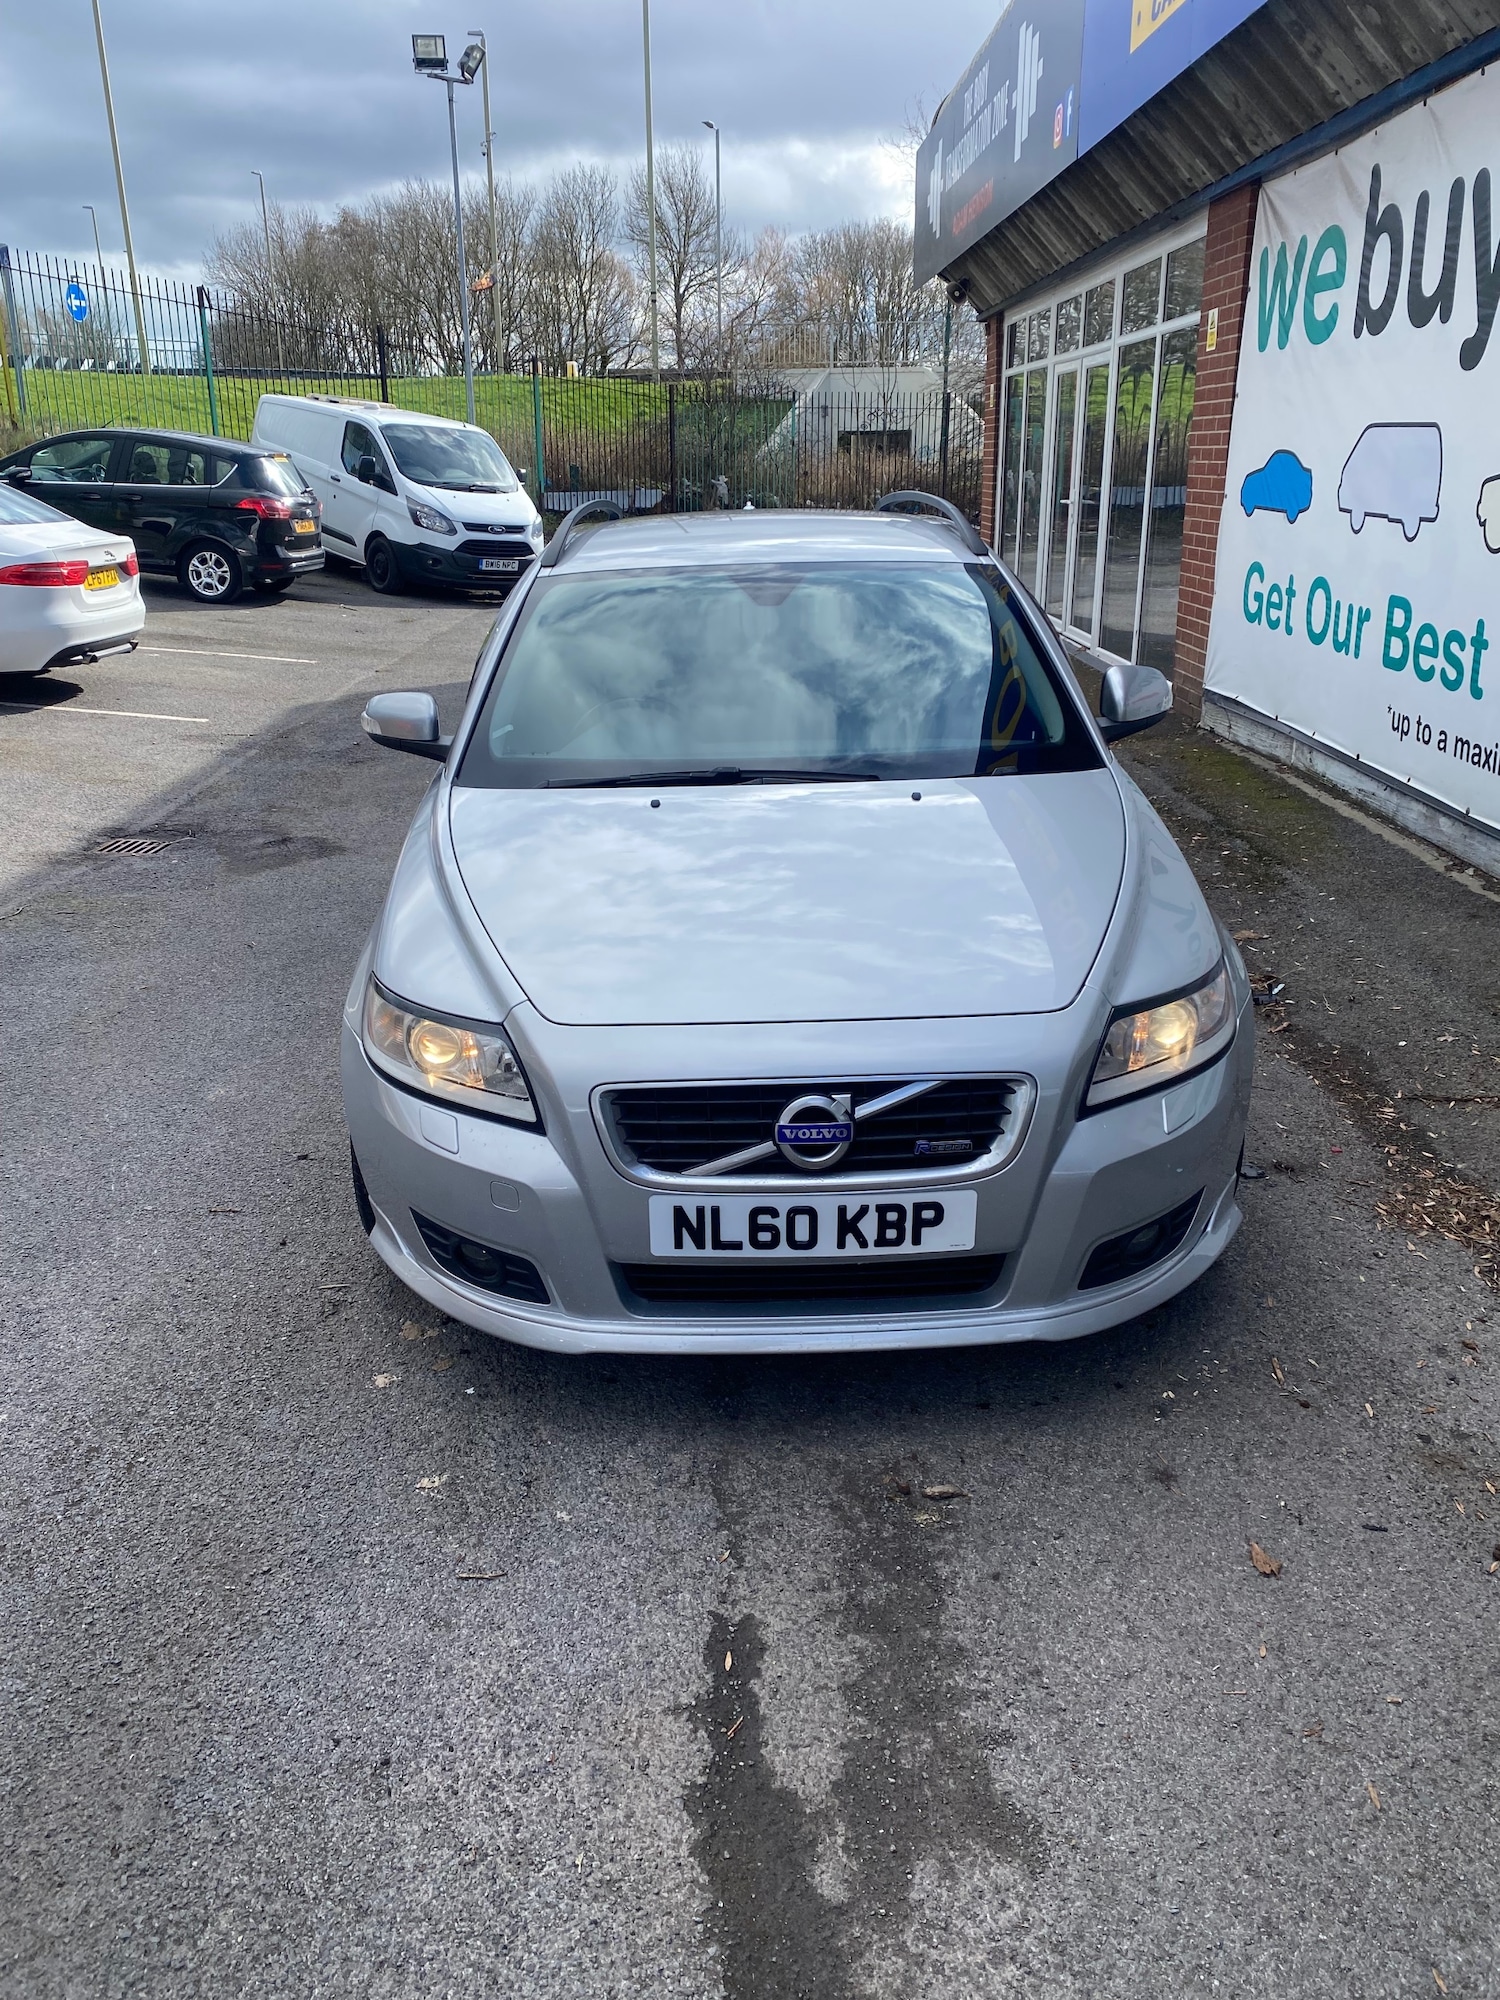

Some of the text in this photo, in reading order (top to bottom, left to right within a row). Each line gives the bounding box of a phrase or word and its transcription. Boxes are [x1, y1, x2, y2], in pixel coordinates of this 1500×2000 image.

[1258, 163, 1500, 371] we buy
[1243, 561, 1489, 700] Get Our Best
[1416, 714, 1432, 745] to
[1437, 730, 1448, 753] a
[782, 1128, 848, 1139] VOLVO
[673, 1201, 945, 1250] NL60 KBP
